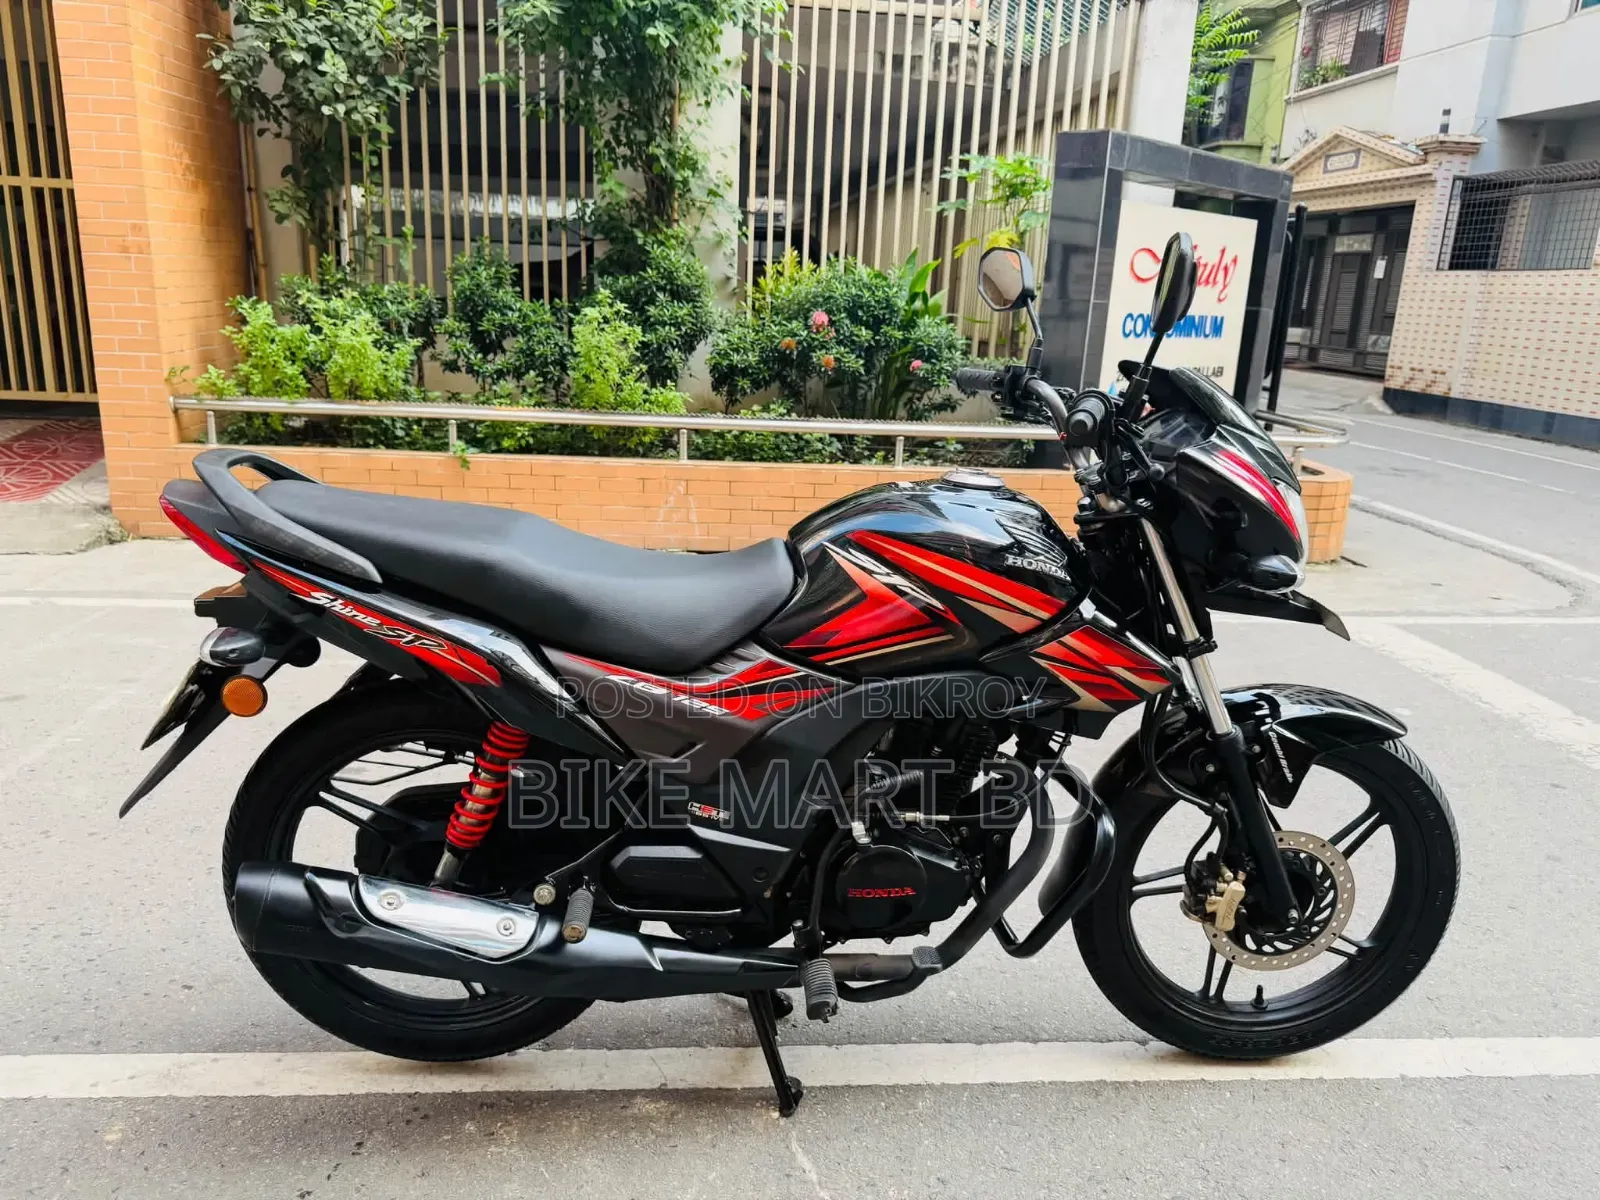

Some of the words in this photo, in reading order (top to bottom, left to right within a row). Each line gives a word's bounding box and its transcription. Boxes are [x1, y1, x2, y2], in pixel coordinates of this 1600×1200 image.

[1122, 312, 1224, 339] CONOMINIUM
[1004, 554, 1071, 581] HONDA
[304, 591, 381, 627] Shine
[363, 625, 448, 651] SP
[847, 887, 917, 898] HONDA
